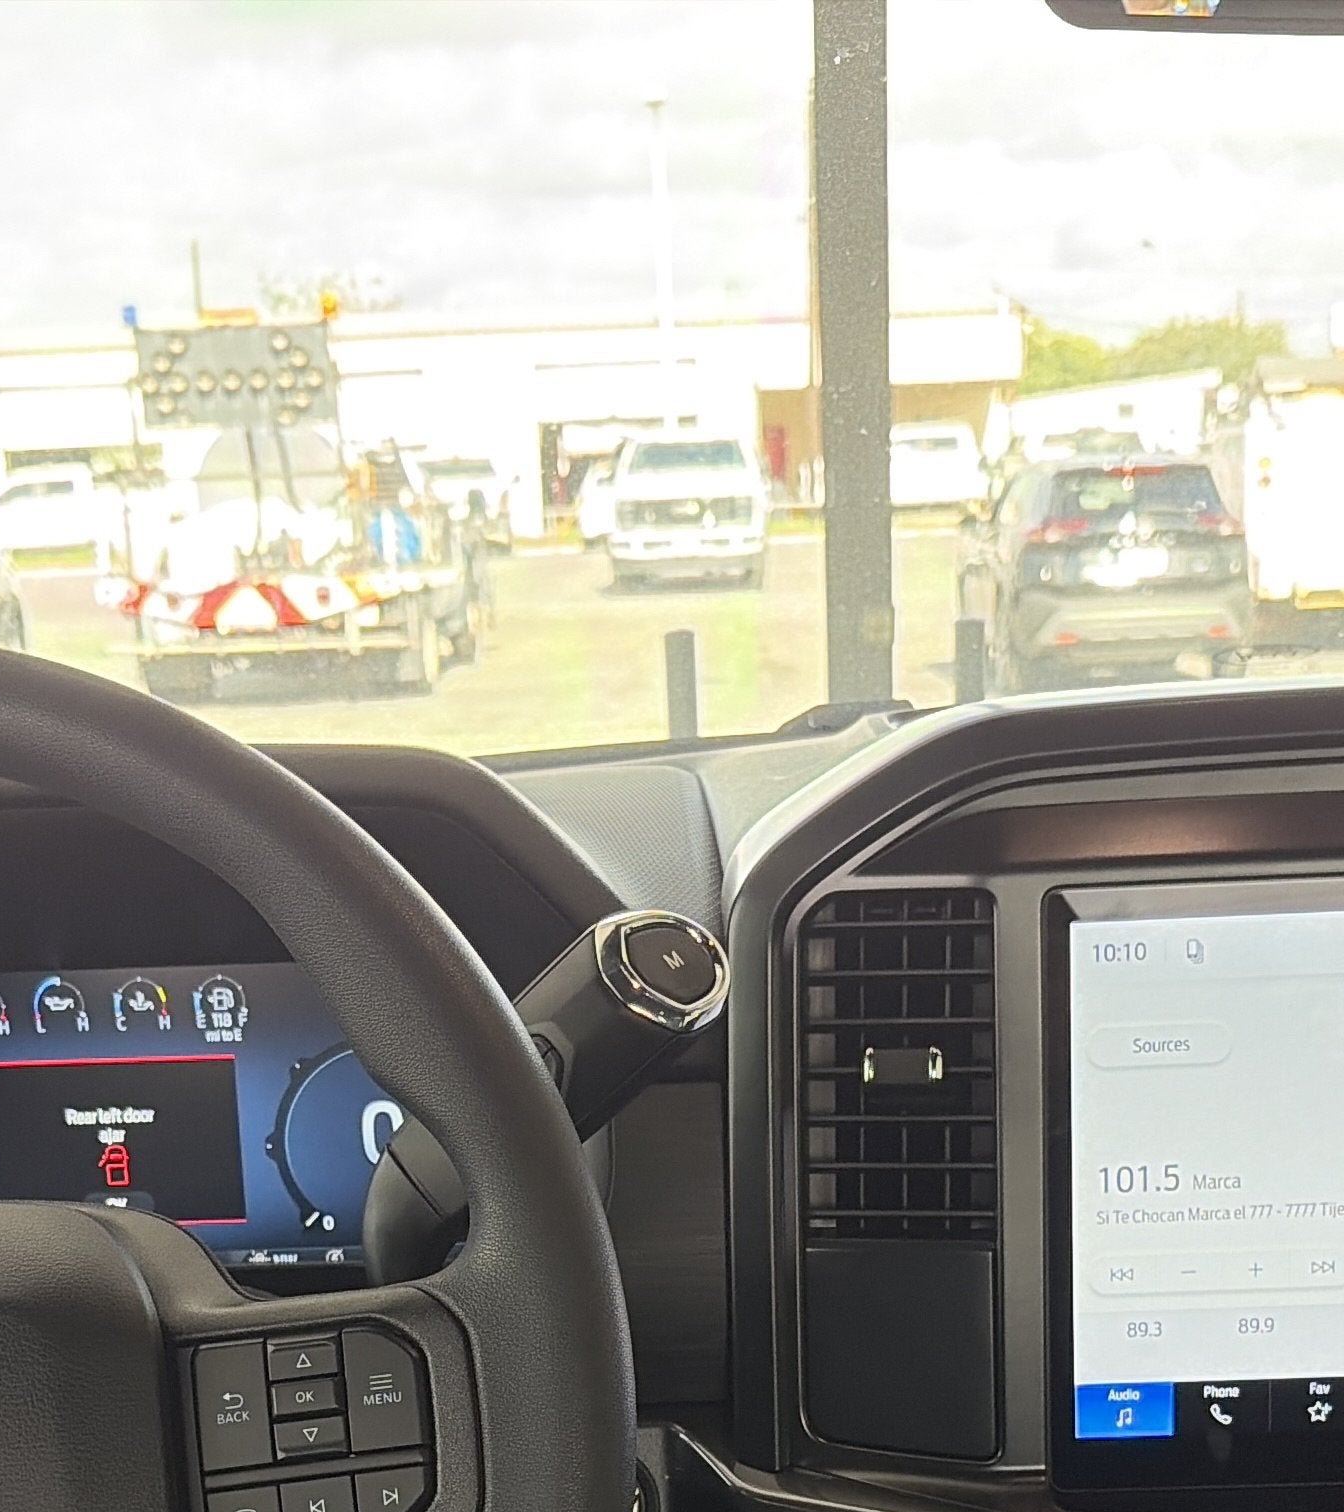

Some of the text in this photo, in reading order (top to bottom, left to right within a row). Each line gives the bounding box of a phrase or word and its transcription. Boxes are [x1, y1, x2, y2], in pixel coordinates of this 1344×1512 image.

[662, 950, 685, 970] M
[1092, 942, 1147, 962] 10:10
[35, 1017, 47, 1034] L
[76, 1016, 89, 1032] H
[116, 1016, 127, 1032] C
[158, 1014, 171, 1030] H
[196, 1011, 248, 1028] E 118 F
[221, 1029, 234, 1042] to
[234, 1028, 243, 1042] E
[1132, 1037, 1190, 1054] Sources
[64, 1106, 155, 1125] Rear left door
[98, 1127, 126, 1145] ajar
[1098, 1163, 1242, 1194] 101.5 Marca
[1096, 1209, 1110, 1225] Si
[1112, 1209, 1130, 1224] Te
[1132, 1208, 1185, 1224] Chocan
[1188, 1206, 1231, 1222] Marca
[1233, 1204, 1247, 1220] el
[1249, 1203, 1274, 1220] 777
[1285, 1202, 1318, 1219] 7777
[322, 1215, 335, 1231] 0
[1126, 1320, 1163, 1338] 89.3
[1237, 1317, 1275, 1335] 89.9
[1107, 1389, 1140, 1402] Audio
[1203, 1384, 1240, 1399] Phone
[1308, 1381, 1330, 1396] Fav
[294, 1390, 316, 1404] OK
[362, 1391, 403, 1406] MENU
[216, 1411, 251, 1425] BACK
